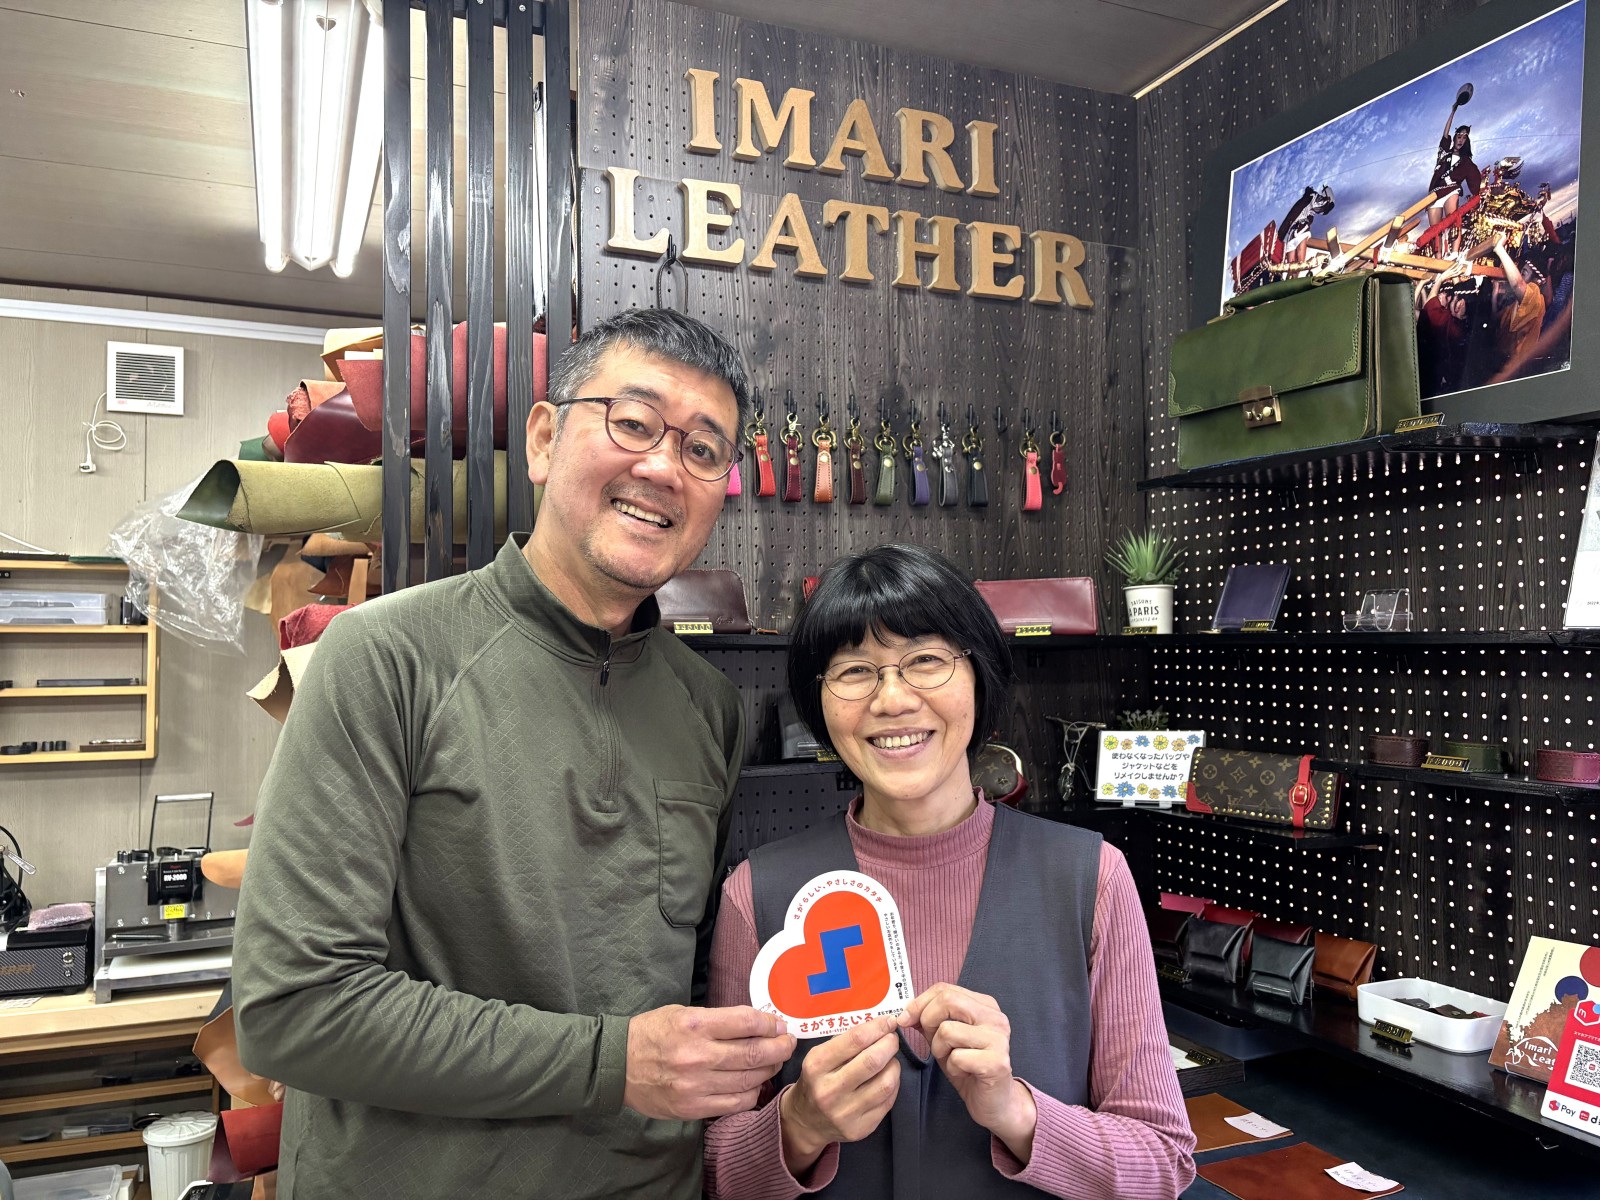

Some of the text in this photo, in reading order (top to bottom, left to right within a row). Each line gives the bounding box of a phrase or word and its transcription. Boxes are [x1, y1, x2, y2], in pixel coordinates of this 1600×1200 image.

[684, 68, 1000, 199] IMARI
[604, 166, 1094, 309] LEATHER
[1133, 605, 1159, 616] PARIS
[794, 878, 882, 920] さがらしい、やさしさのカタチ
[799, 1012, 874, 1033] さがすたいる
[1524, 1041, 1552, 1055] Imari
[1560, 1104, 1576, 1117] Pay
[1590, 1115, 1600, 1126] d
